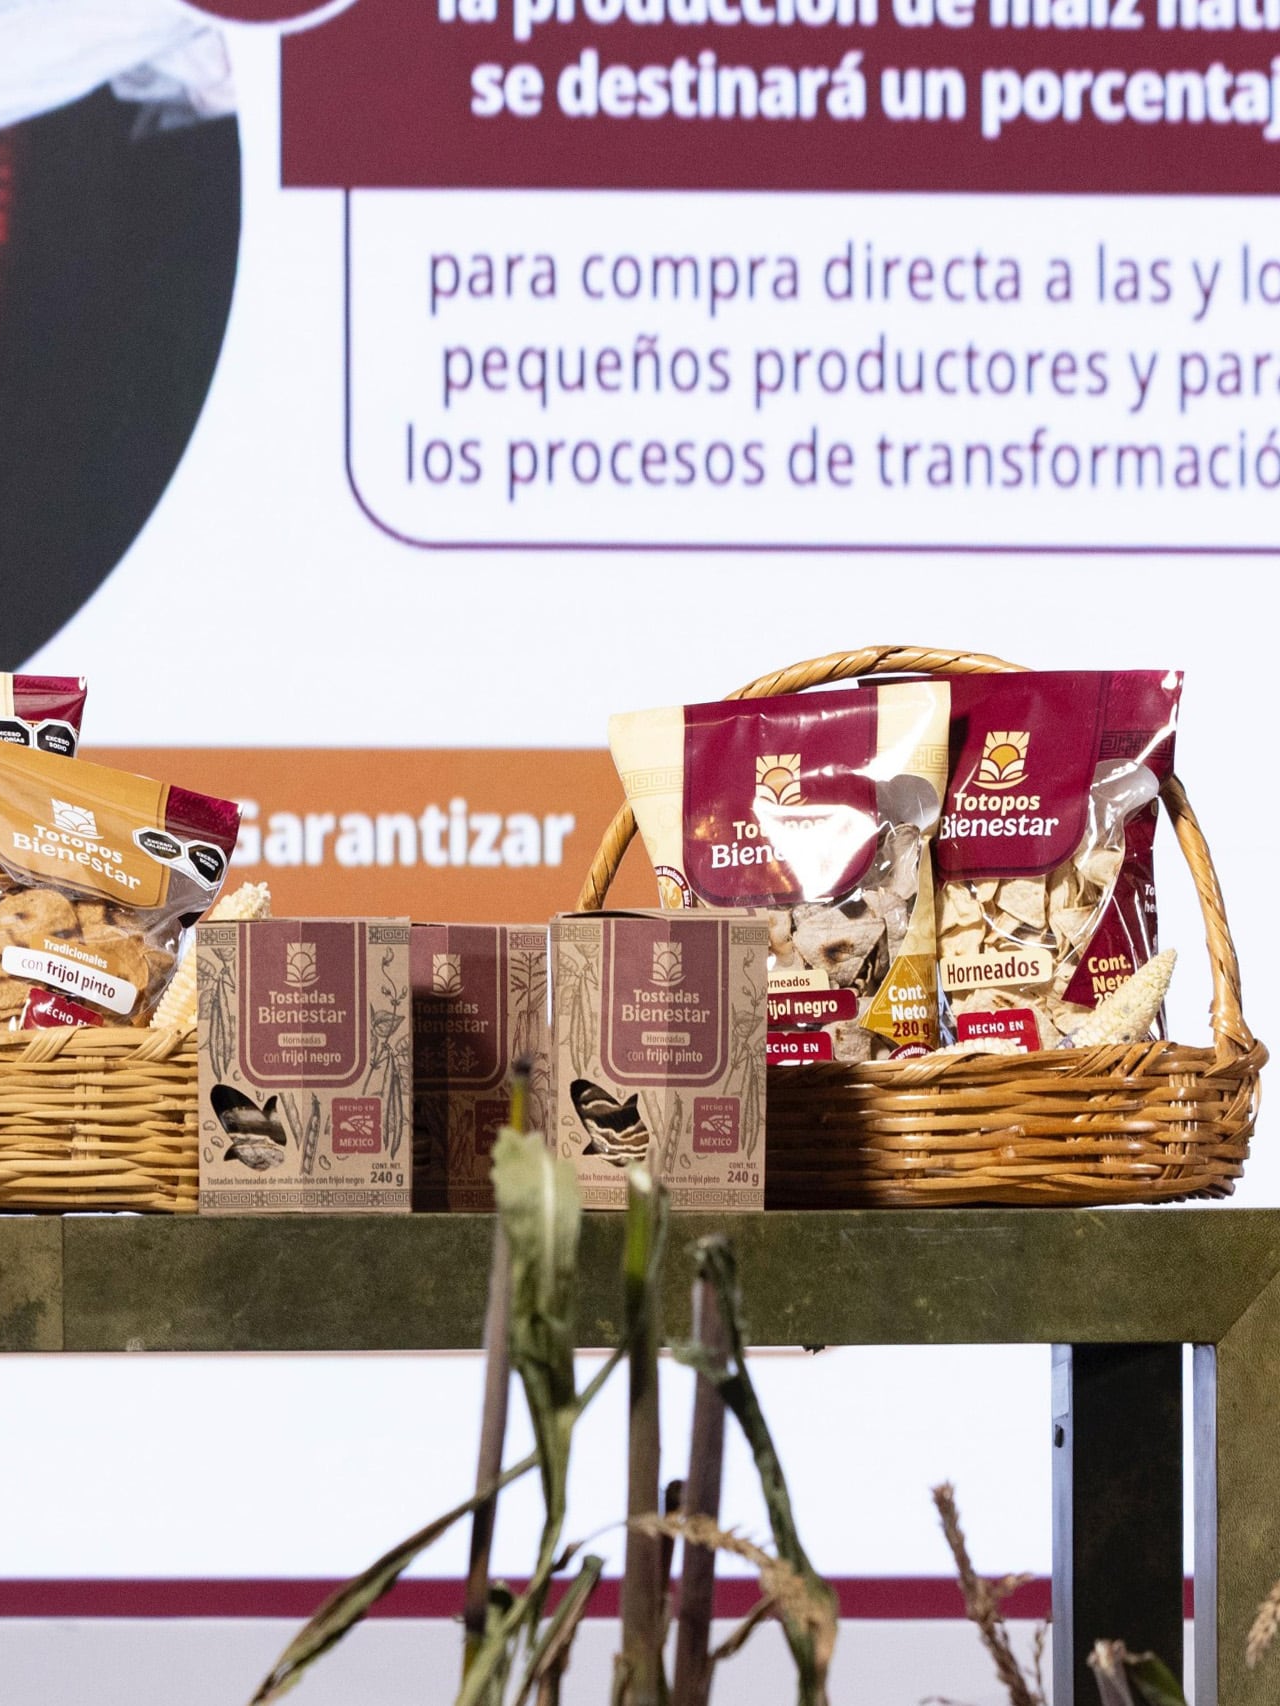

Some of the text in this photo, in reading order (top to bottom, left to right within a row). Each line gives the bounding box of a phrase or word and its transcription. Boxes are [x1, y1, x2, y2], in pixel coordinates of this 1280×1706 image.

[471, 63, 544, 117] se
[557, 47, 866, 120] destinará
[881, 67, 966, 121] un
[431, 254, 556, 316] para
[582, 254, 798, 318] compra
[824, 241, 1020, 302] directa
[1046, 258, 1071, 302] a
[1098, 243, 1172, 303] las
[1193, 258, 1220, 322] y
[444, 332, 1280, 414] pequeños productores y par
[408, 423, 1280, 502] los procesos de transformació
[953, 793, 1040, 816] Totopos
[939, 813, 1059, 840] Bienestar
[33, 824, 123, 864] Totopos
[12, 832, 141, 890] Bienestar
[44, 939, 107, 969] Tradicionales
[947, 956, 1040, 984] Horneados
[1088, 954, 1132, 974] Cont.
[21, 958, 115, 998] con frijol pinto
[767, 977, 810, 989] rneados
[269, 990, 335, 1004] Tostadas
[633, 989, 700, 1003] Tostadas
[888, 985, 926, 1002] Cont.
[43, 1005, 73, 1024] ECHO
[258, 1006, 346, 1024] Bienestar
[622, 1004, 710, 1023] Bienestar
[794, 999, 838, 1018] negro
[892, 1004, 927, 1021] Neto
[413, 1015, 488, 1033] ienestar
[893, 1021, 919, 1038] 280
[968, 1021, 1024, 1035] HECHO EN
[628, 1048, 703, 1065] con frijol pinto
[766, 1043, 819, 1053] ECHO EN
[264, 1050, 341, 1066] con frijol negro
[700, 1135, 732, 1146] MÉXICO
[370, 1171, 404, 1186] 240 g
[727, 1171, 759, 1185] 240 g
